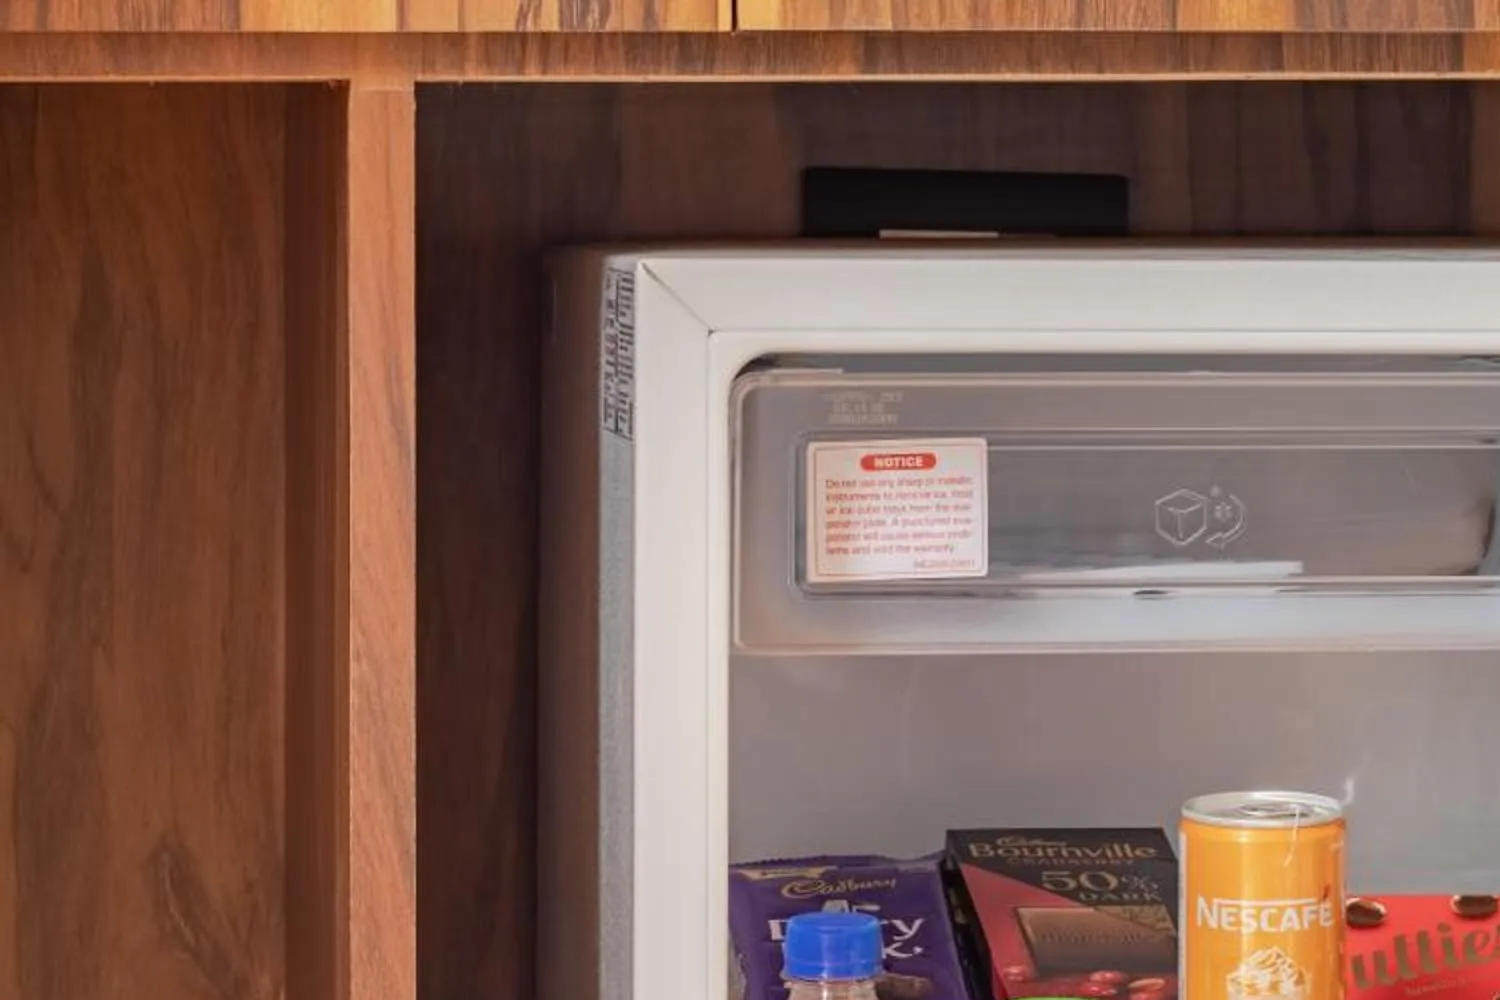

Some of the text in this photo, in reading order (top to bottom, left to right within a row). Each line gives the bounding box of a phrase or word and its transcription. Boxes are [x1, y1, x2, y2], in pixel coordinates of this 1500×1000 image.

[874, 456, 924, 468] NOTICE
[969, 842, 1159, 859] Bournville
[780, 877, 897, 900] Cadbury
[1041, 870, 1160, 892] 50%
[1080, 891, 1161, 902] DARK
